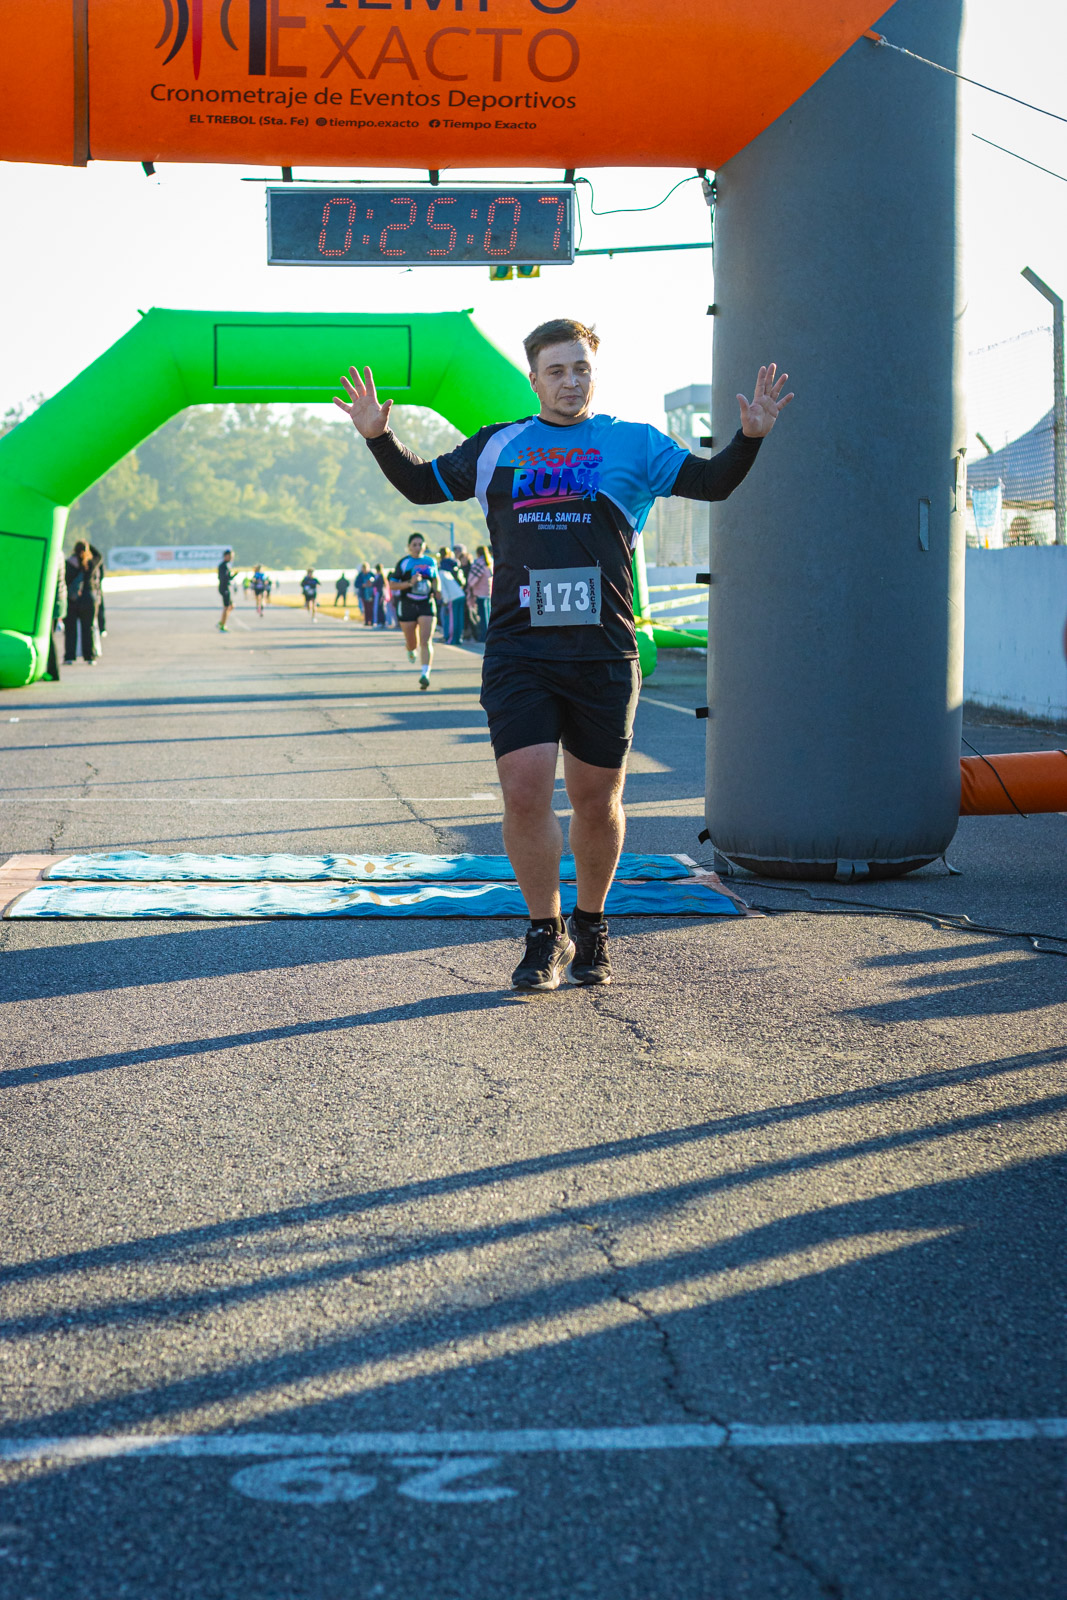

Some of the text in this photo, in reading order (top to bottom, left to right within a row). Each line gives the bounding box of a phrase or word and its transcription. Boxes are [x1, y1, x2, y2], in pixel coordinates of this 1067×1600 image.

[269, 0, 580, 83] EXACTO
[150, 83, 577, 112] Cronometraje de Eventos Deportivos
[189, 114, 309, 127] EL TREBOL (Sta. Fe)
[329, 117, 420, 129] tiempo.exacto
[443, 118, 537, 131] Tiempo Exacto
[317, 197, 565, 256] 0:25:07
[518, 512, 592, 524] RAFAELA, SANTA FE
[535, 580, 544, 616] TIEMPO
[543, 581, 590, 612] 173
[588, 578, 597, 614] EXACTO
